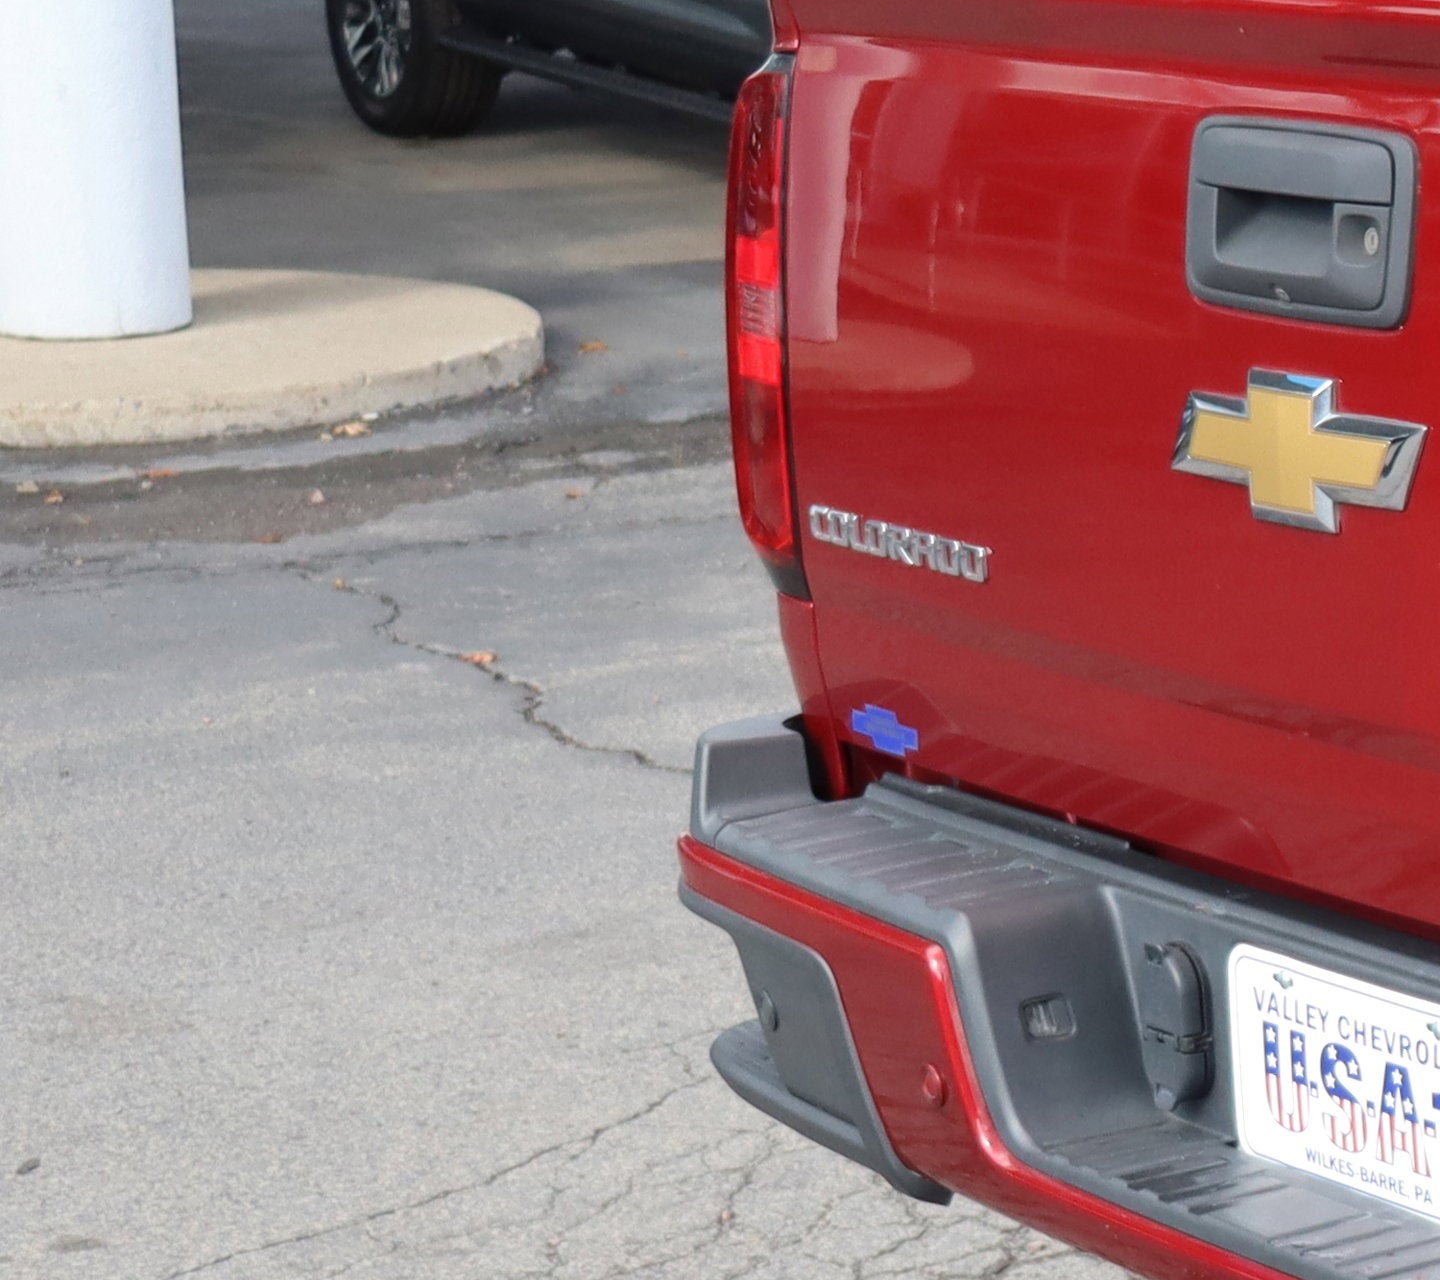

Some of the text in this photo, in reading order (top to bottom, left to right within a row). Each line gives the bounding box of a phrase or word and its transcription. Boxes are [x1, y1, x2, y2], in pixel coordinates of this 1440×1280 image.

[809, 504, 988, 583] COLORADO
[1253, 986, 1330, 1033] VALLEY
[1414, 1185, 1434, 1205] PA
